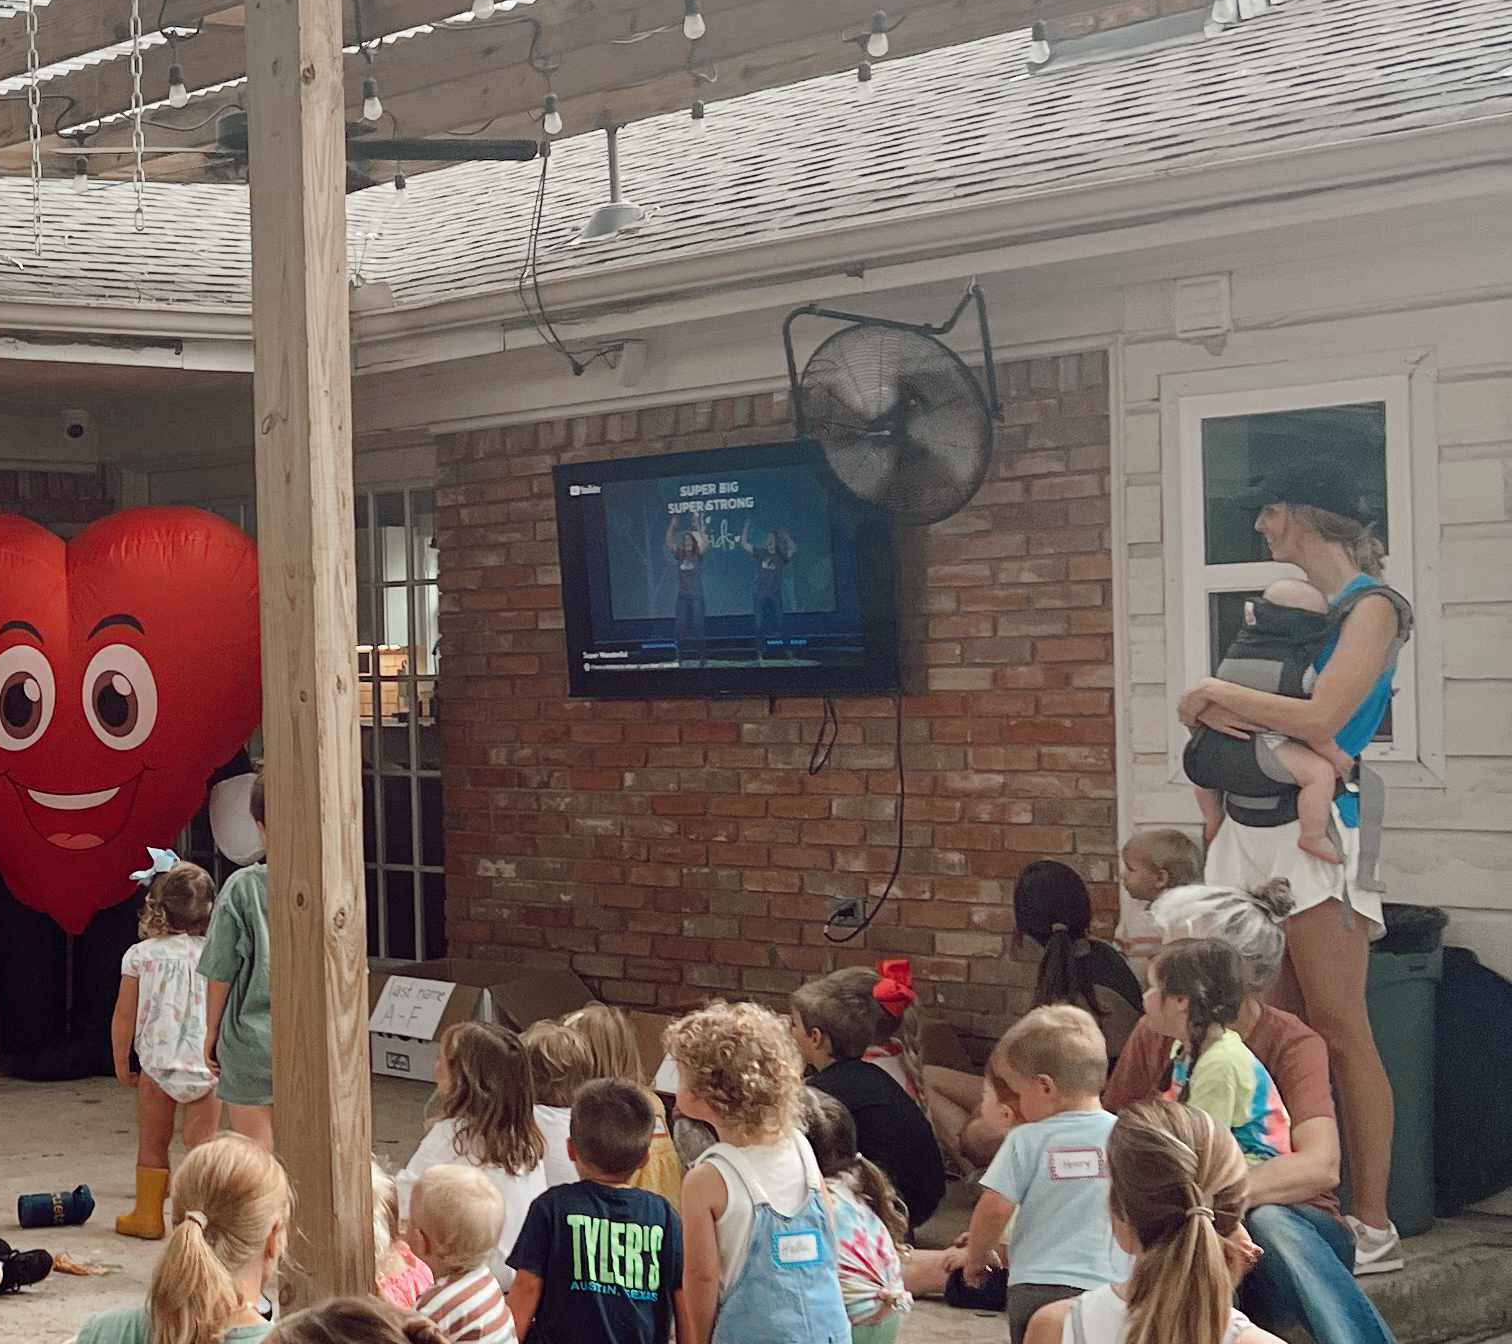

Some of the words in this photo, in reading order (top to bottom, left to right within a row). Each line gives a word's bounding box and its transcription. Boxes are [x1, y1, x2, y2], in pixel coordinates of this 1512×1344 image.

[679, 483, 717, 497] SUPER
[718, 481, 740, 494] BIG
[667, 501, 704, 514] SUPER
[704, 496, 755, 511] STRONG
[567, 1214, 664, 1292] TYLER'S
[624, 1288, 658, 1303] TEXAS
